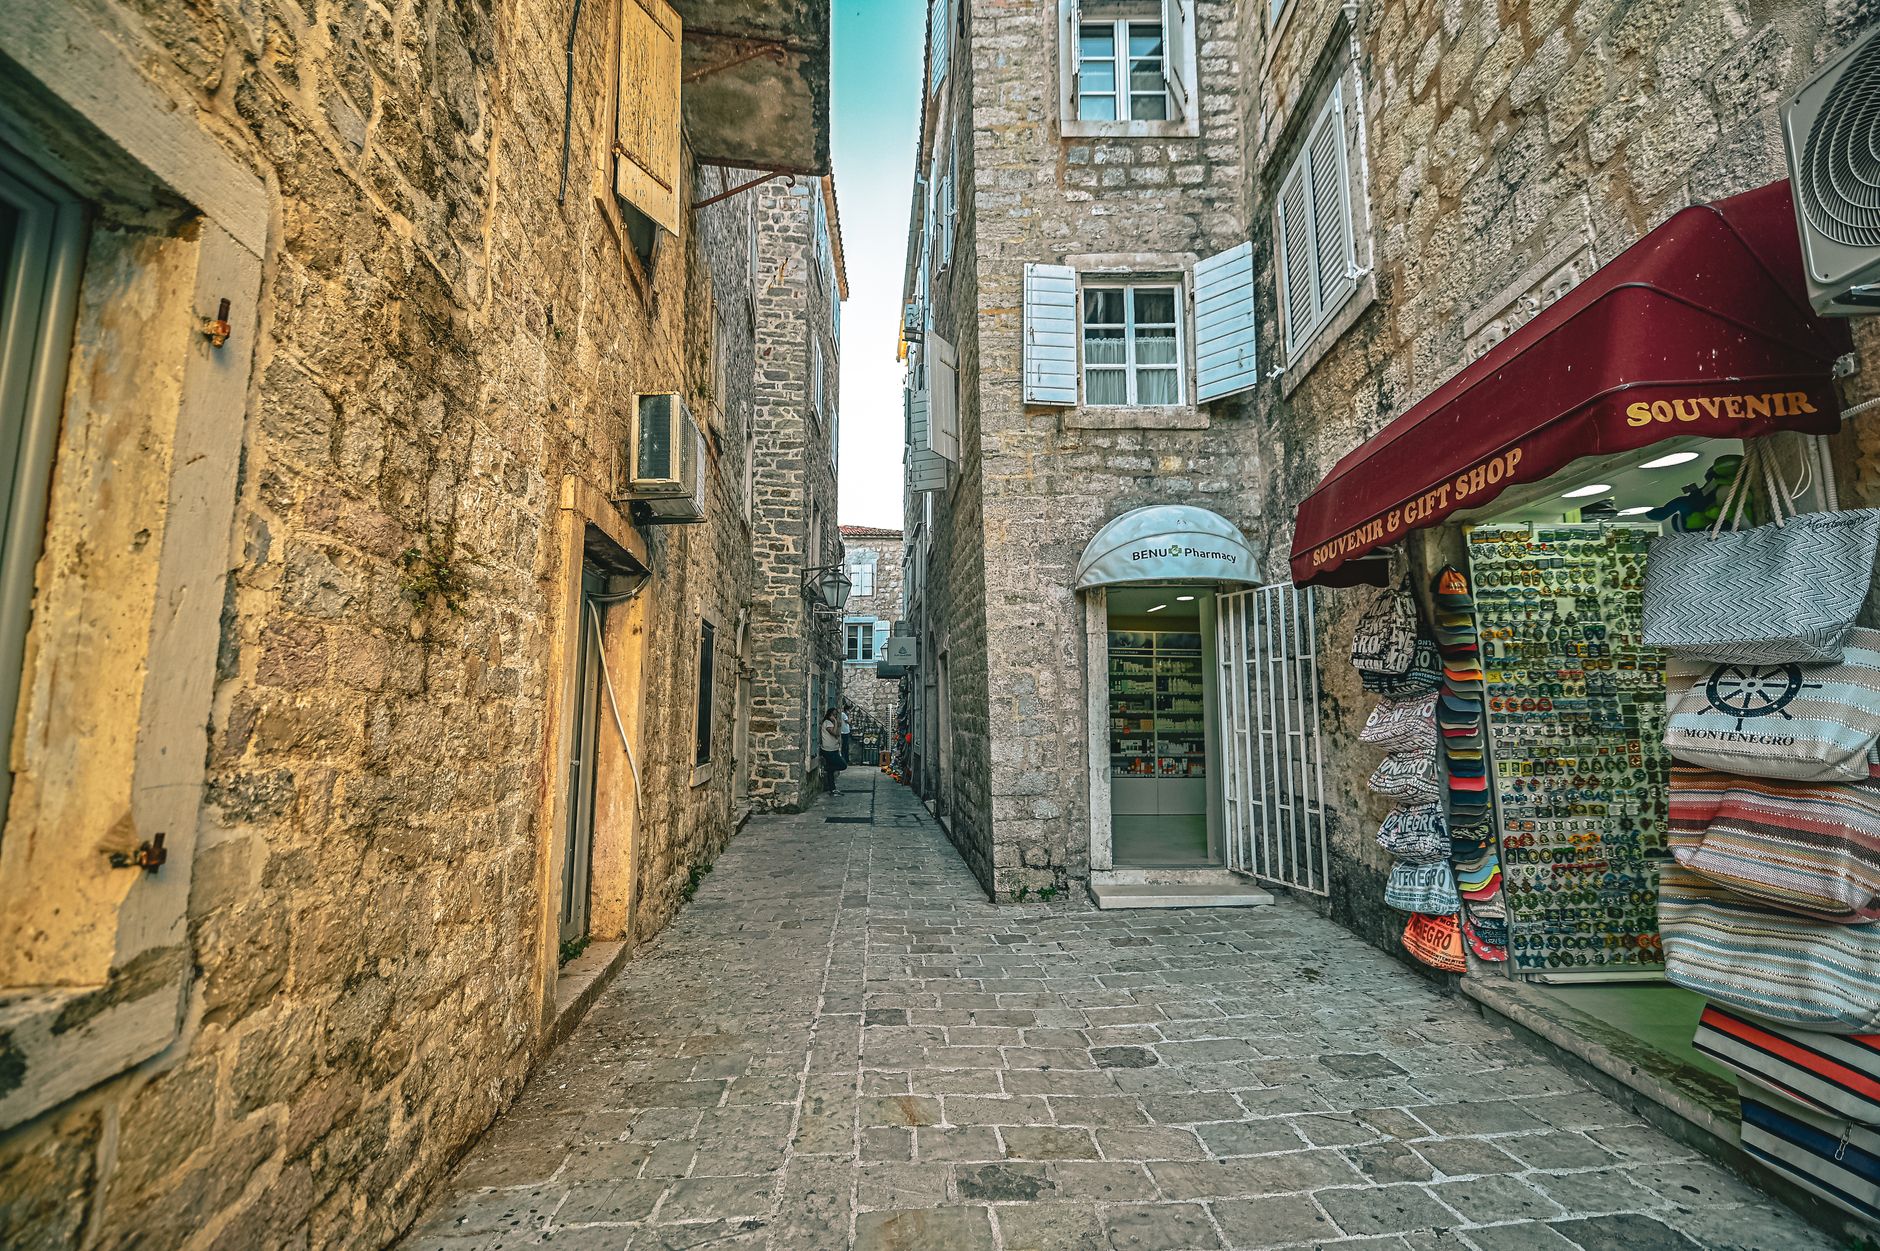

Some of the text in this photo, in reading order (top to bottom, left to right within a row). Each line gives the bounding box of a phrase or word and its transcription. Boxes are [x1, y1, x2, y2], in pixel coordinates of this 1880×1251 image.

[1626, 391, 1818, 427] SOUVENIR
[1312, 447, 1522, 566] SOUVENIR & GIFT SHOP
[1132, 547, 1237, 564] BENU Pharmacy
[1683, 728, 1795, 747] MONTENEGRO
